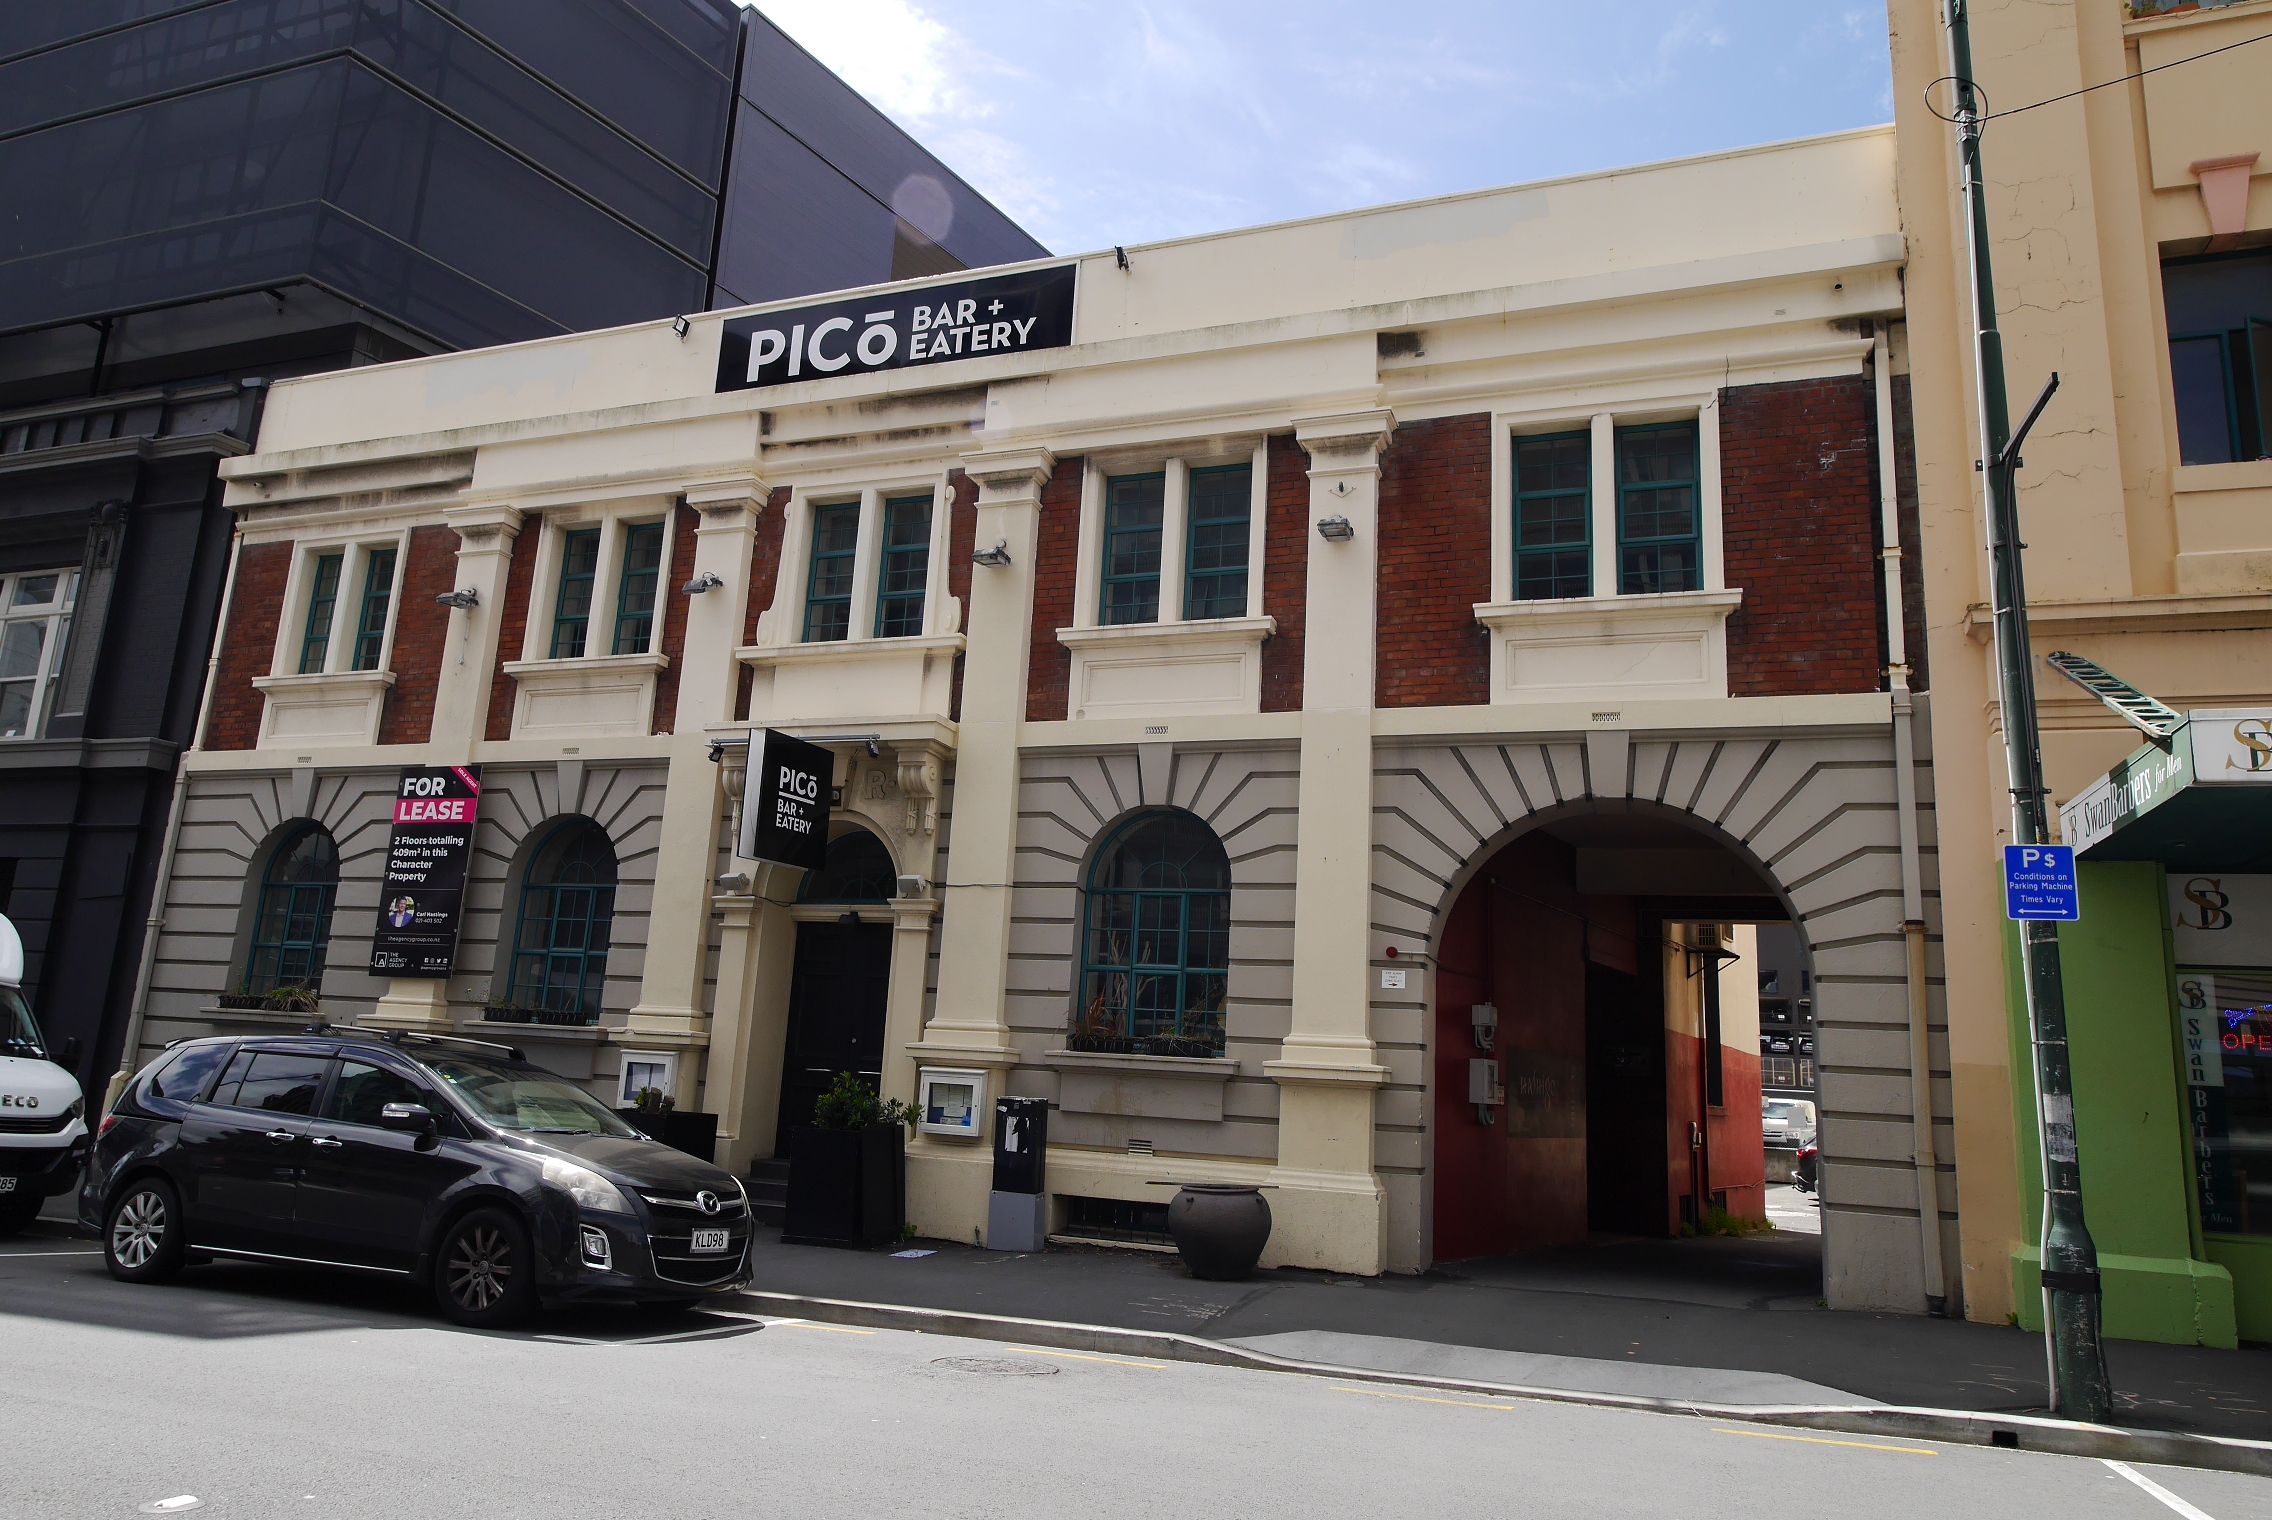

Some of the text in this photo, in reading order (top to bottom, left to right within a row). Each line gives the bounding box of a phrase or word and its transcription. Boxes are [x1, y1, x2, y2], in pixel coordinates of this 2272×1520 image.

[911, 299, 977, 332] BAR
[908, 316, 1037, 361] EATERY
[2154, 763, 2166, 793] for
[2166, 754, 2182, 779] Men
[402, 777, 446, 796] FOR
[399, 801, 465, 820] LEASE
[777, 798, 797, 817] BAR
[775, 813, 812, 835] EATERY
[394, 835, 464, 847] 2 Floors totalling
[422, 847, 431, 857] in
[432, 847, 448, 857] this
[2022, 848, 2056, 869] P $
[391, 860, 433, 869] Character
[389, 871, 427, 883] Property
[2013, 872, 2055, 881] Conditions
[2009, 881, 2073, 891] Parking Machine
[2020, 895, 2064, 905] Times Vary
[695, 1232, 724, 1248] KLD98
